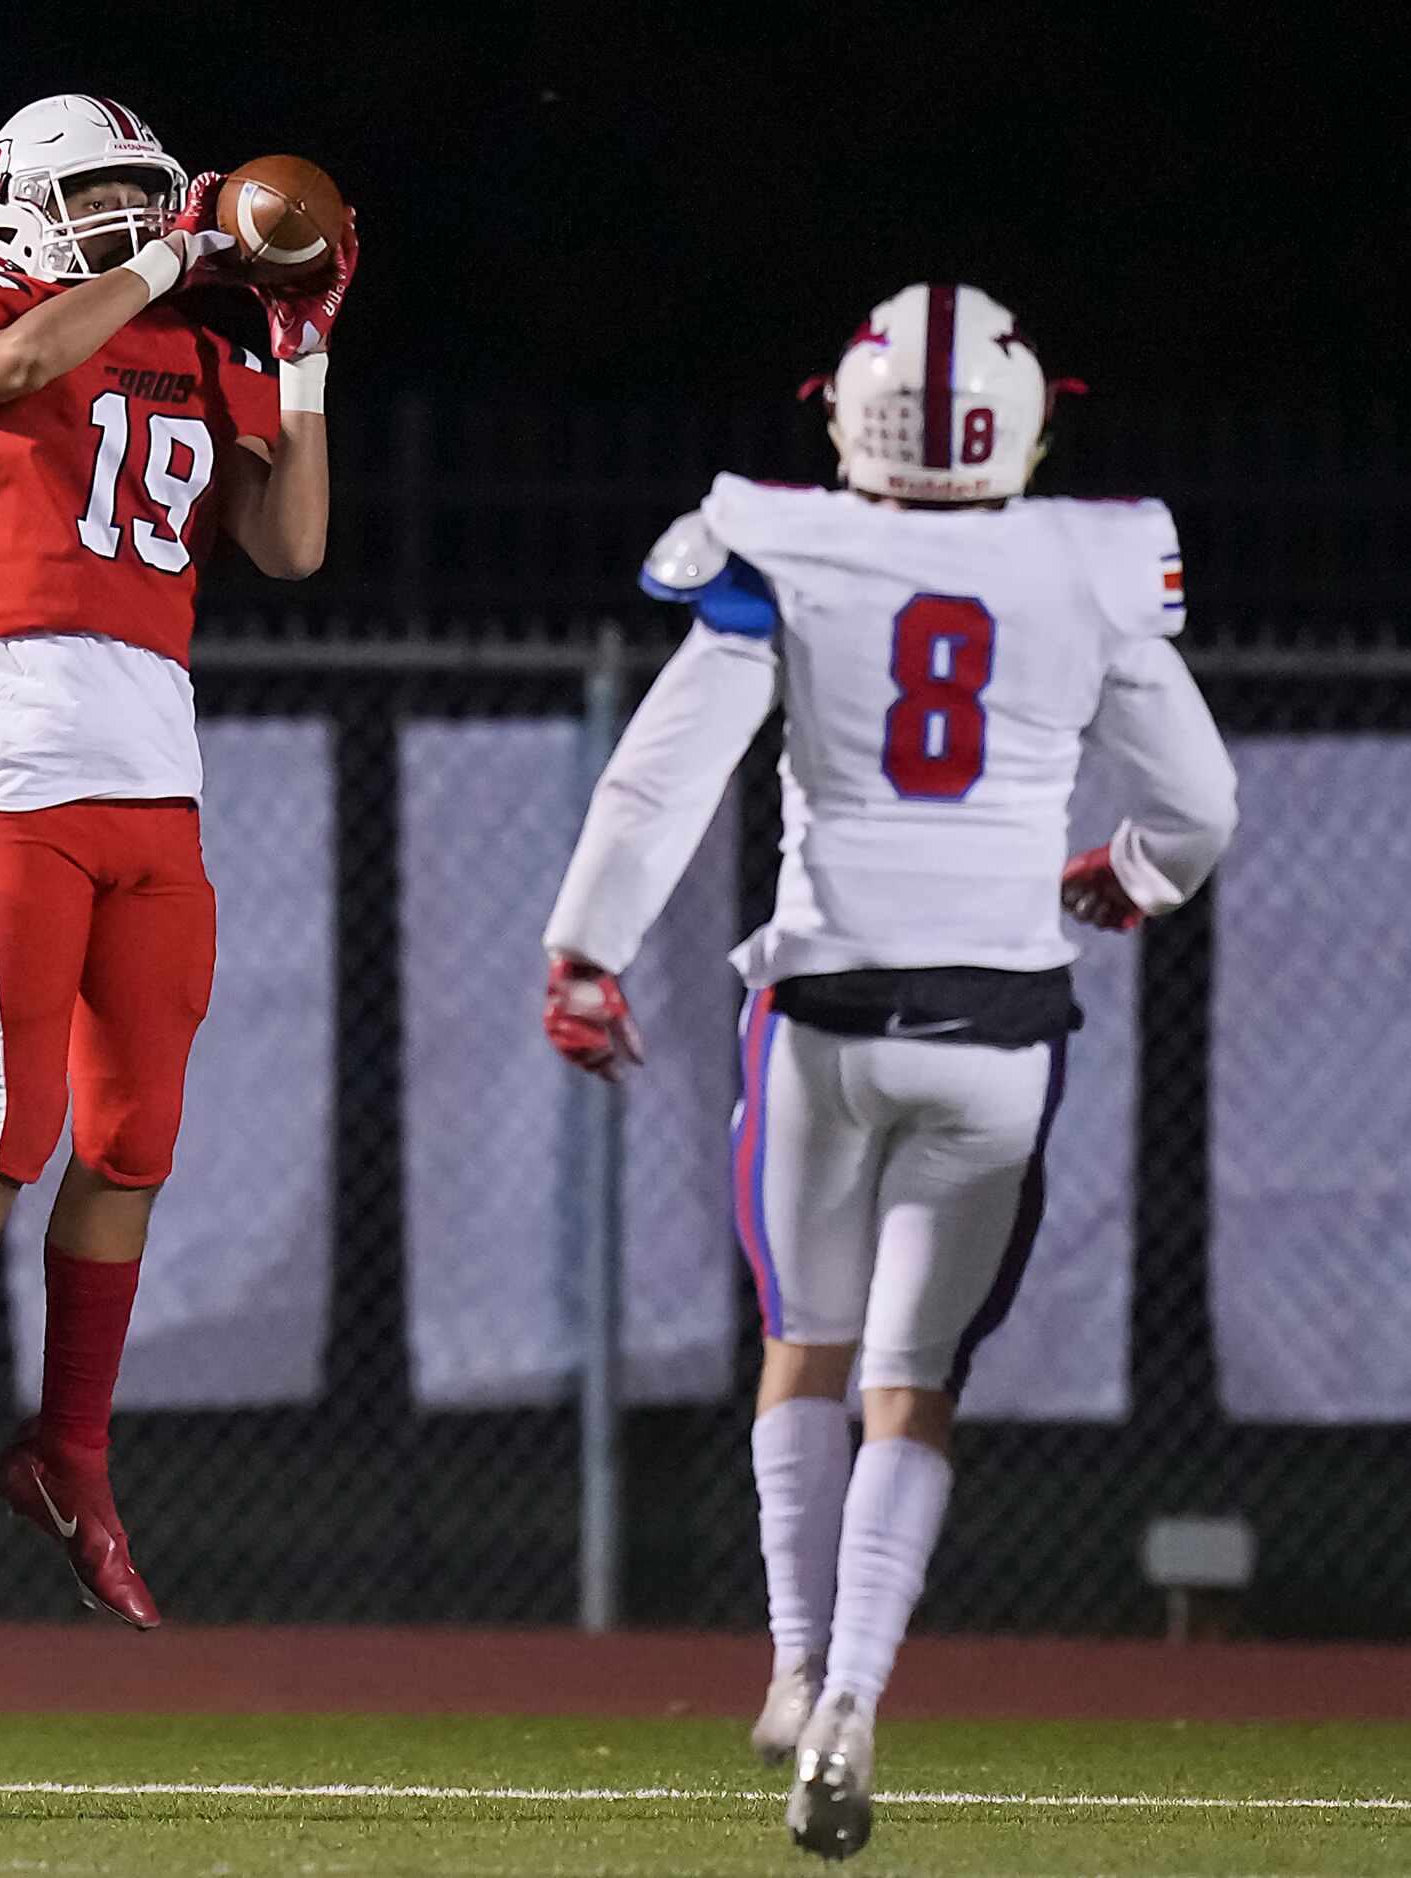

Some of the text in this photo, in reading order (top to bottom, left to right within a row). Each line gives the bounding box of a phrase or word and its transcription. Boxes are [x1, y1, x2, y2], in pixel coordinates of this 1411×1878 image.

[77, 392, 215, 574] 19
[961, 408, 994, 464] 8
[880, 592, 996, 803] 8
